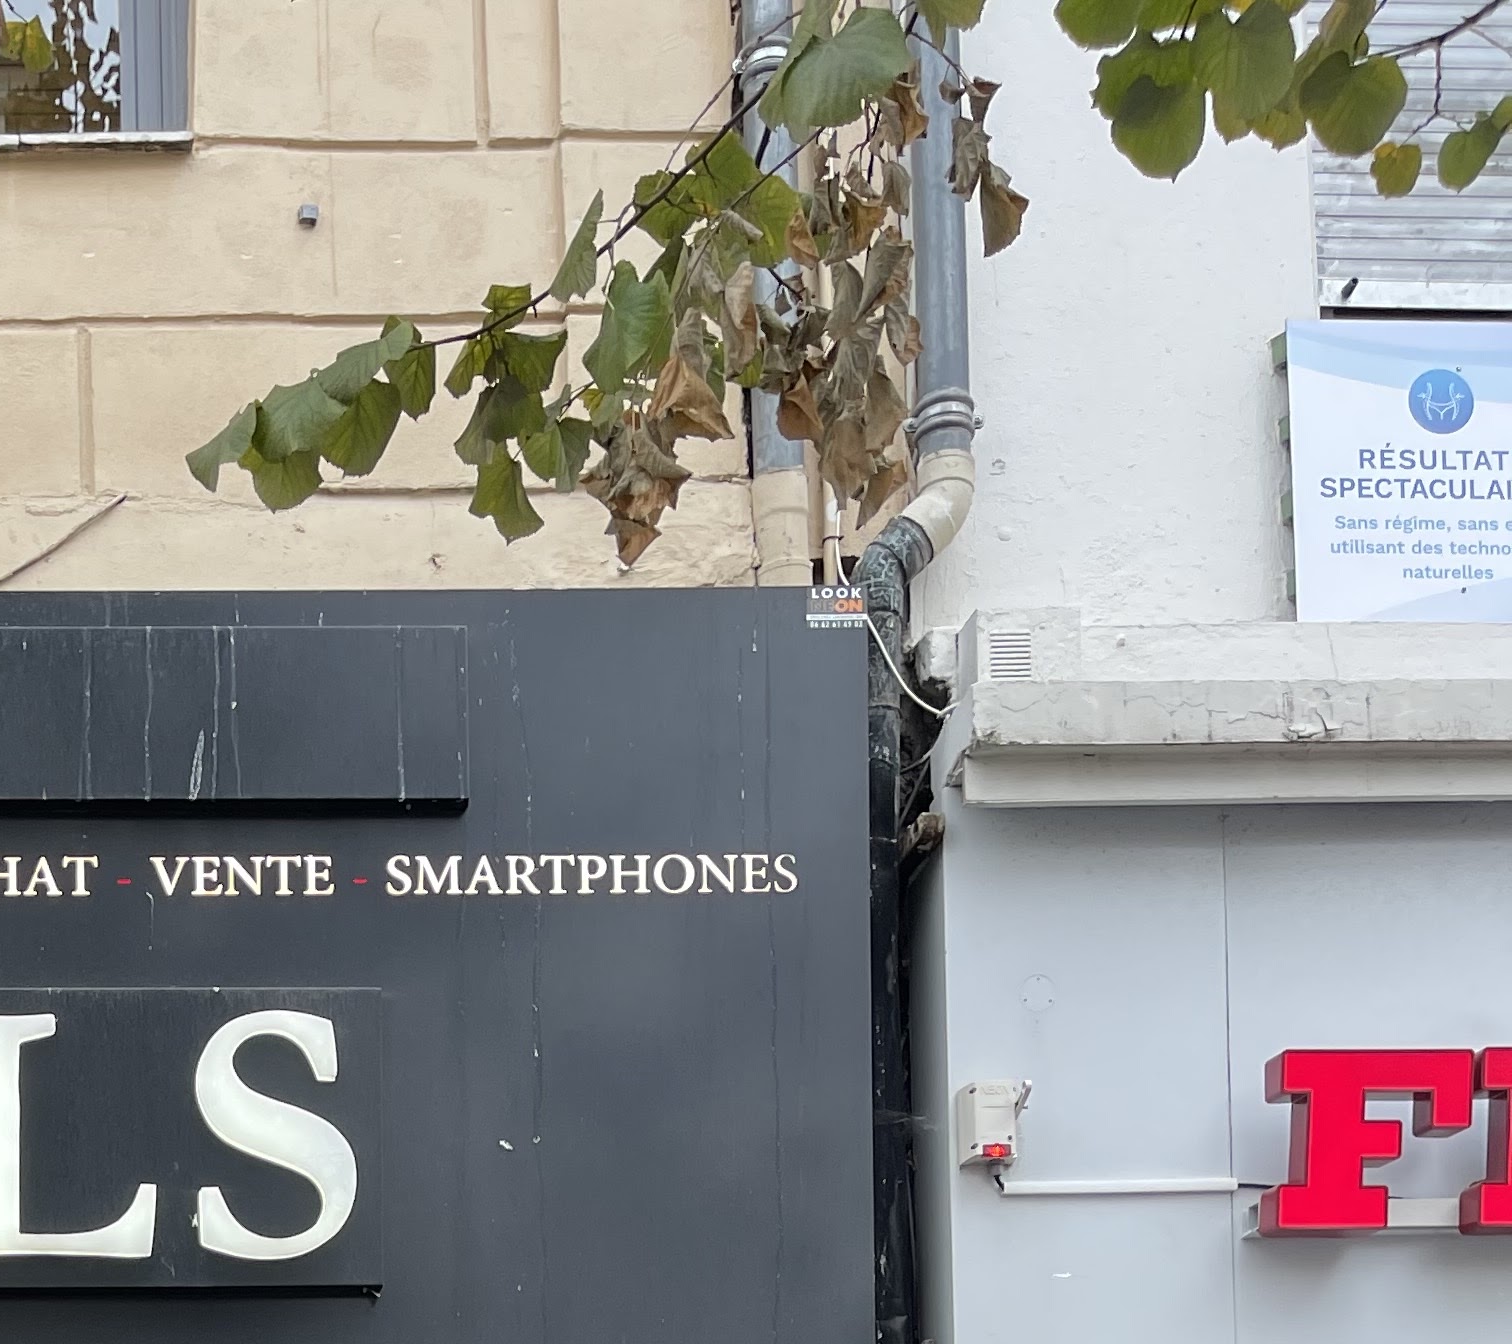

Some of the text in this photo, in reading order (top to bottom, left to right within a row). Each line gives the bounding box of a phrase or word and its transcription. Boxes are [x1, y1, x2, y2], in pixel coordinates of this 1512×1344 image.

[1358, 442, 1509, 471] RÉSULTAT
[1334, 515, 1378, 530] Sans
[1385, 515, 1451, 534] régime,
[1457, 520, 1499, 531] sans
[1330, 539, 1405, 555] utilisant
[1411, 540, 1443, 555] des
[1402, 565, 1494, 580] naturelles
[811, 587, 862, 599] LOOK
[149, 855, 335, 897] VENTE
[385, 852, 799, 896] SMARTPHONES
